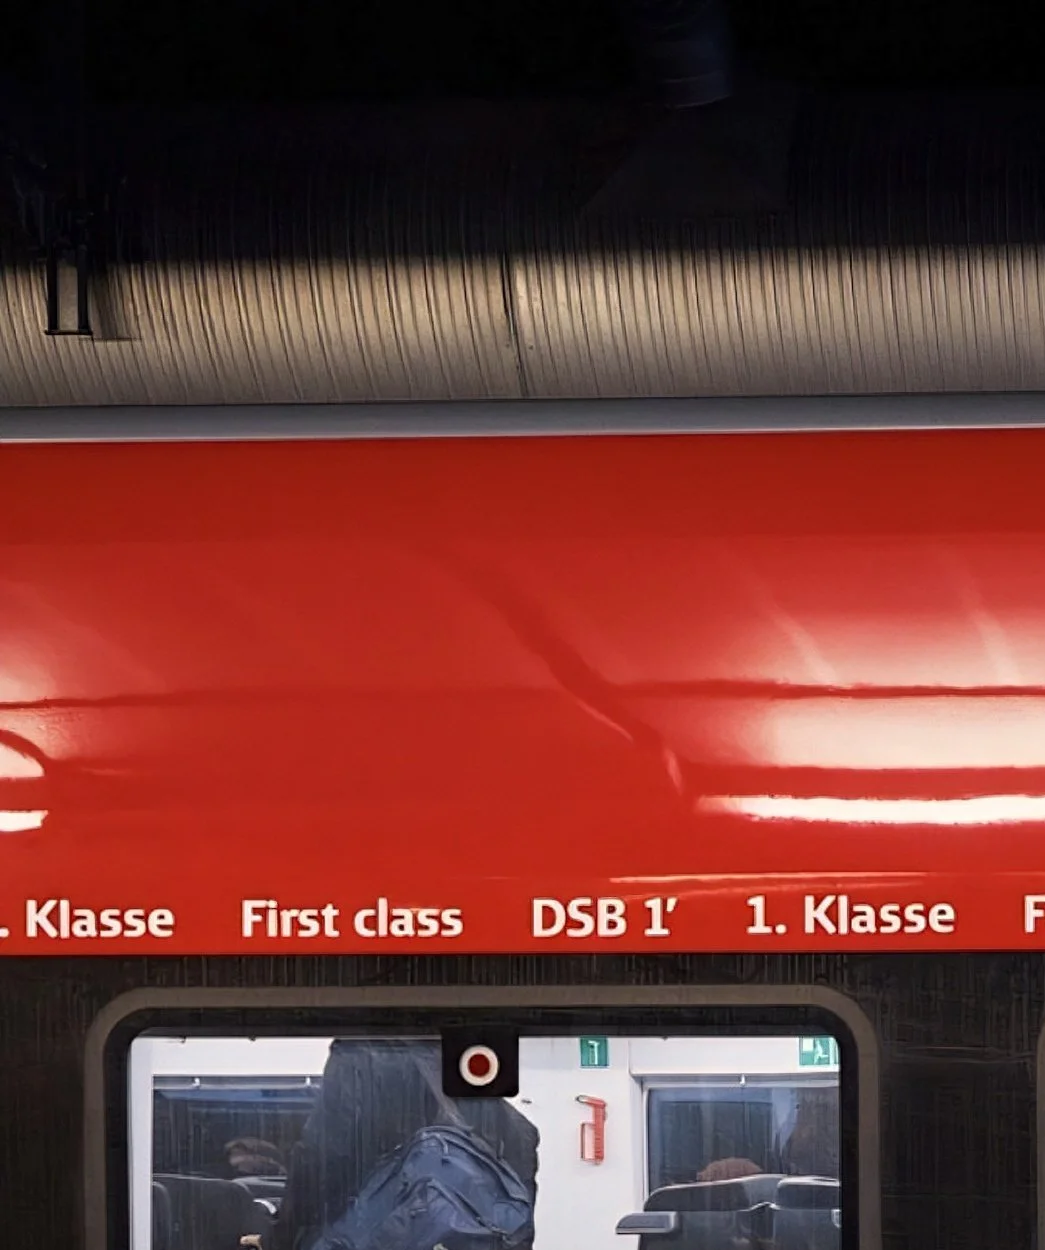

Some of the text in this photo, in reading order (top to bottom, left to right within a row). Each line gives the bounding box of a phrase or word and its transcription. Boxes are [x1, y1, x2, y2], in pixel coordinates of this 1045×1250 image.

[26, 899, 175, 938] Klasse
[241, 898, 464, 937] First class
[532, 898, 627, 938] DSB
[748, 894, 956, 935] 1. Klasse
